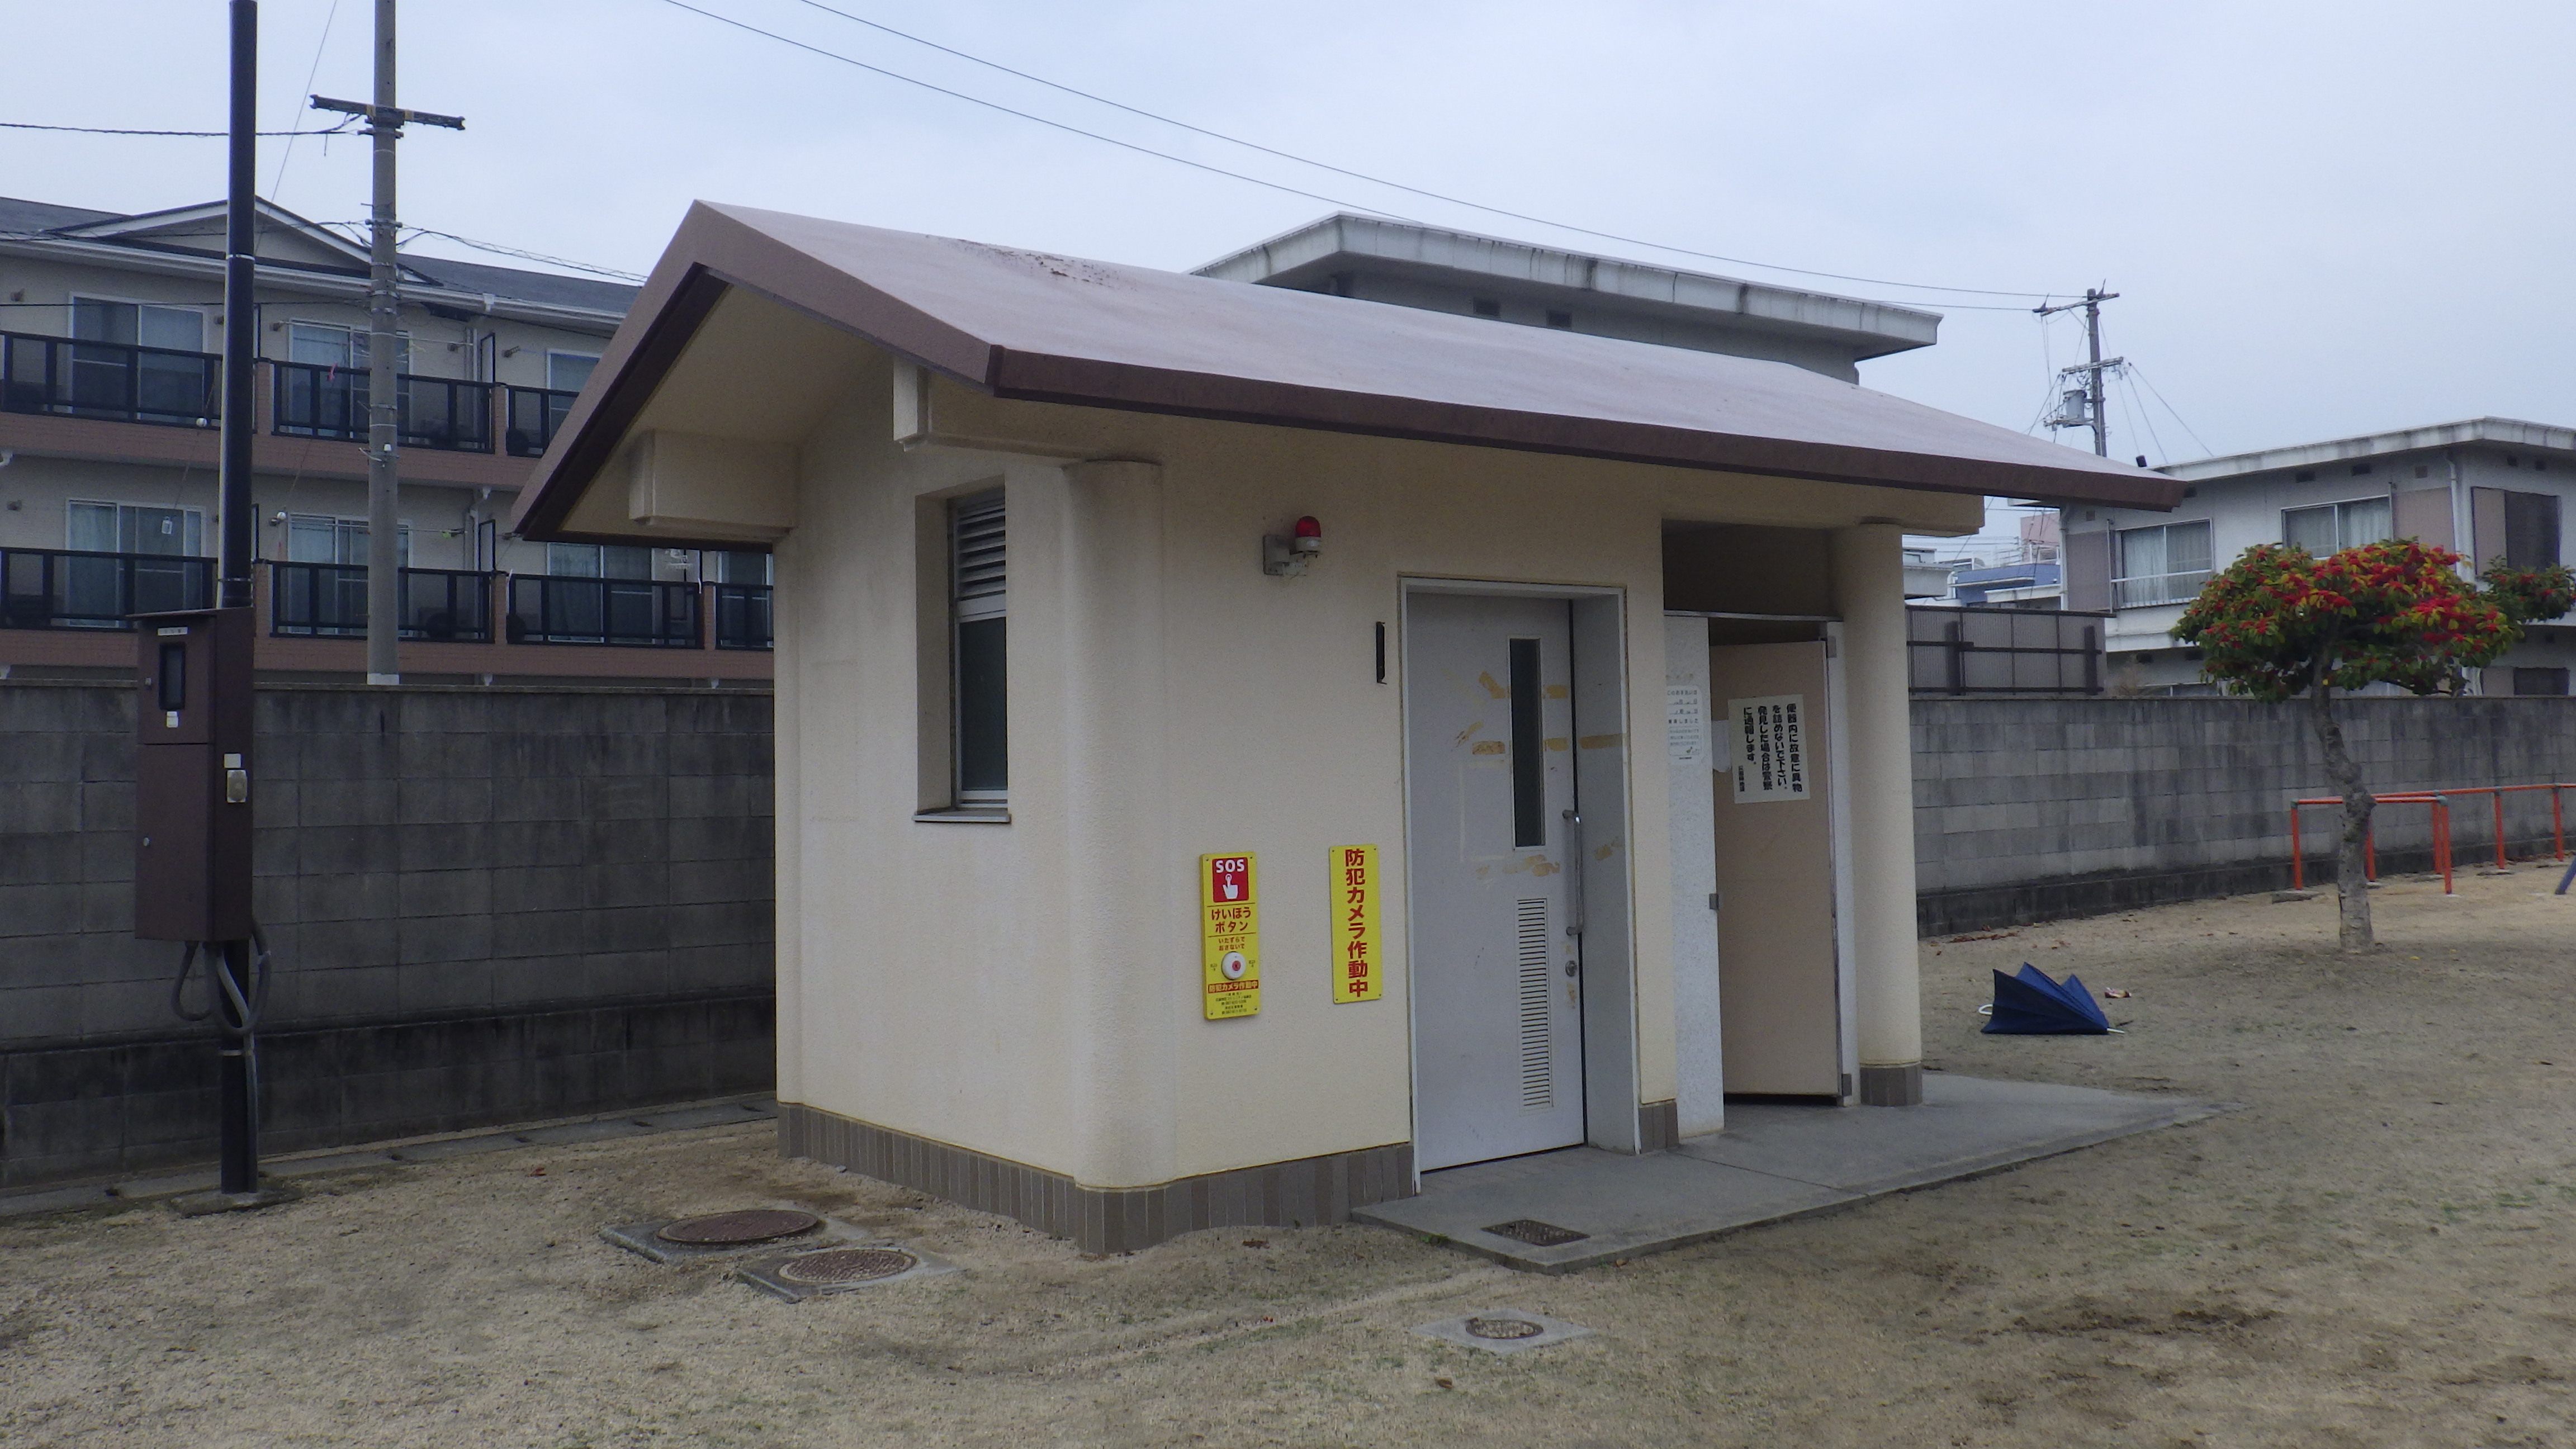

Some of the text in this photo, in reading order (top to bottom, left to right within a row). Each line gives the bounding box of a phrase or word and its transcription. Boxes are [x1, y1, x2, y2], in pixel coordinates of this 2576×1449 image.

[1215, 859, 1245, 873] SOS
[1211, 907, 1252, 920] けいほう
[1215, 921, 1248, 934] ボタン
[1345, 849, 1368, 998] 防犯カメラ作動中
[1209, 981, 1258, 992] 防犯カメラ作動中
